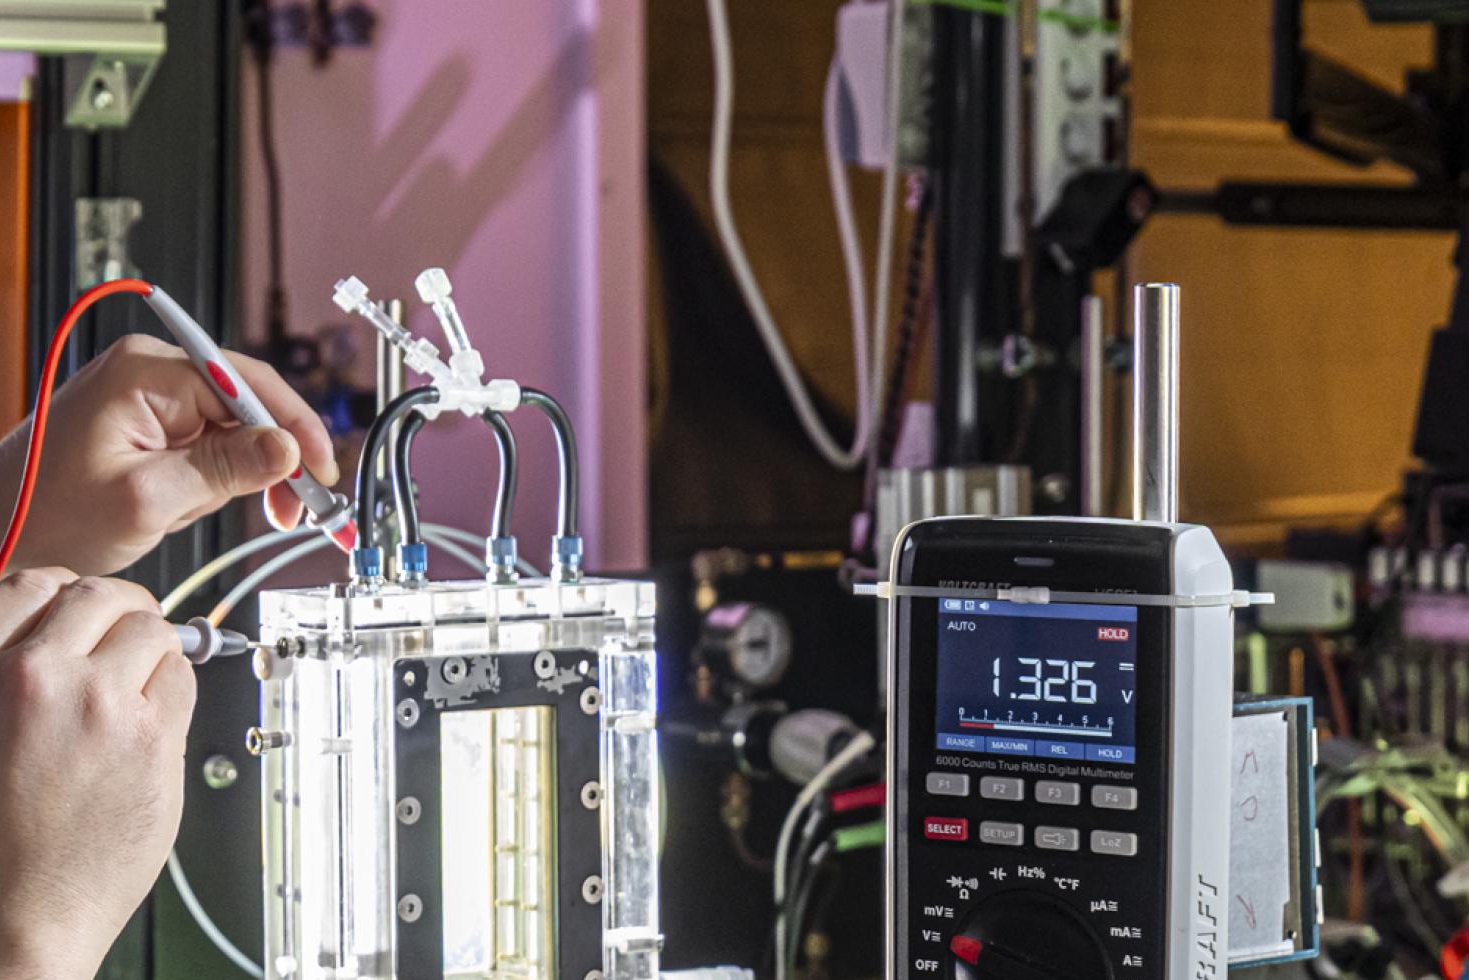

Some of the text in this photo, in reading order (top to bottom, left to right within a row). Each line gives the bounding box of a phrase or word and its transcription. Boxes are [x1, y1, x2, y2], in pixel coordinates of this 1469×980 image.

[947, 621, 976, 631] AUTO
[1098, 627, 1129, 640] HOLD
[993, 657, 1097, 704] 1.326
[1121, 690, 1133, 704] V
[946, 737, 1123, 759] RANGE MAX/MIN REL HOLD
[936, 755, 1134, 780] 6000 Counts True RMS Digital Multimeter
[938, 780, 1120, 803] F1 F2 F3 F4
[927, 823, 963, 835] SELECT
[983, 827, 1016, 840] SETUP
[915, 959, 939, 972] OFF
